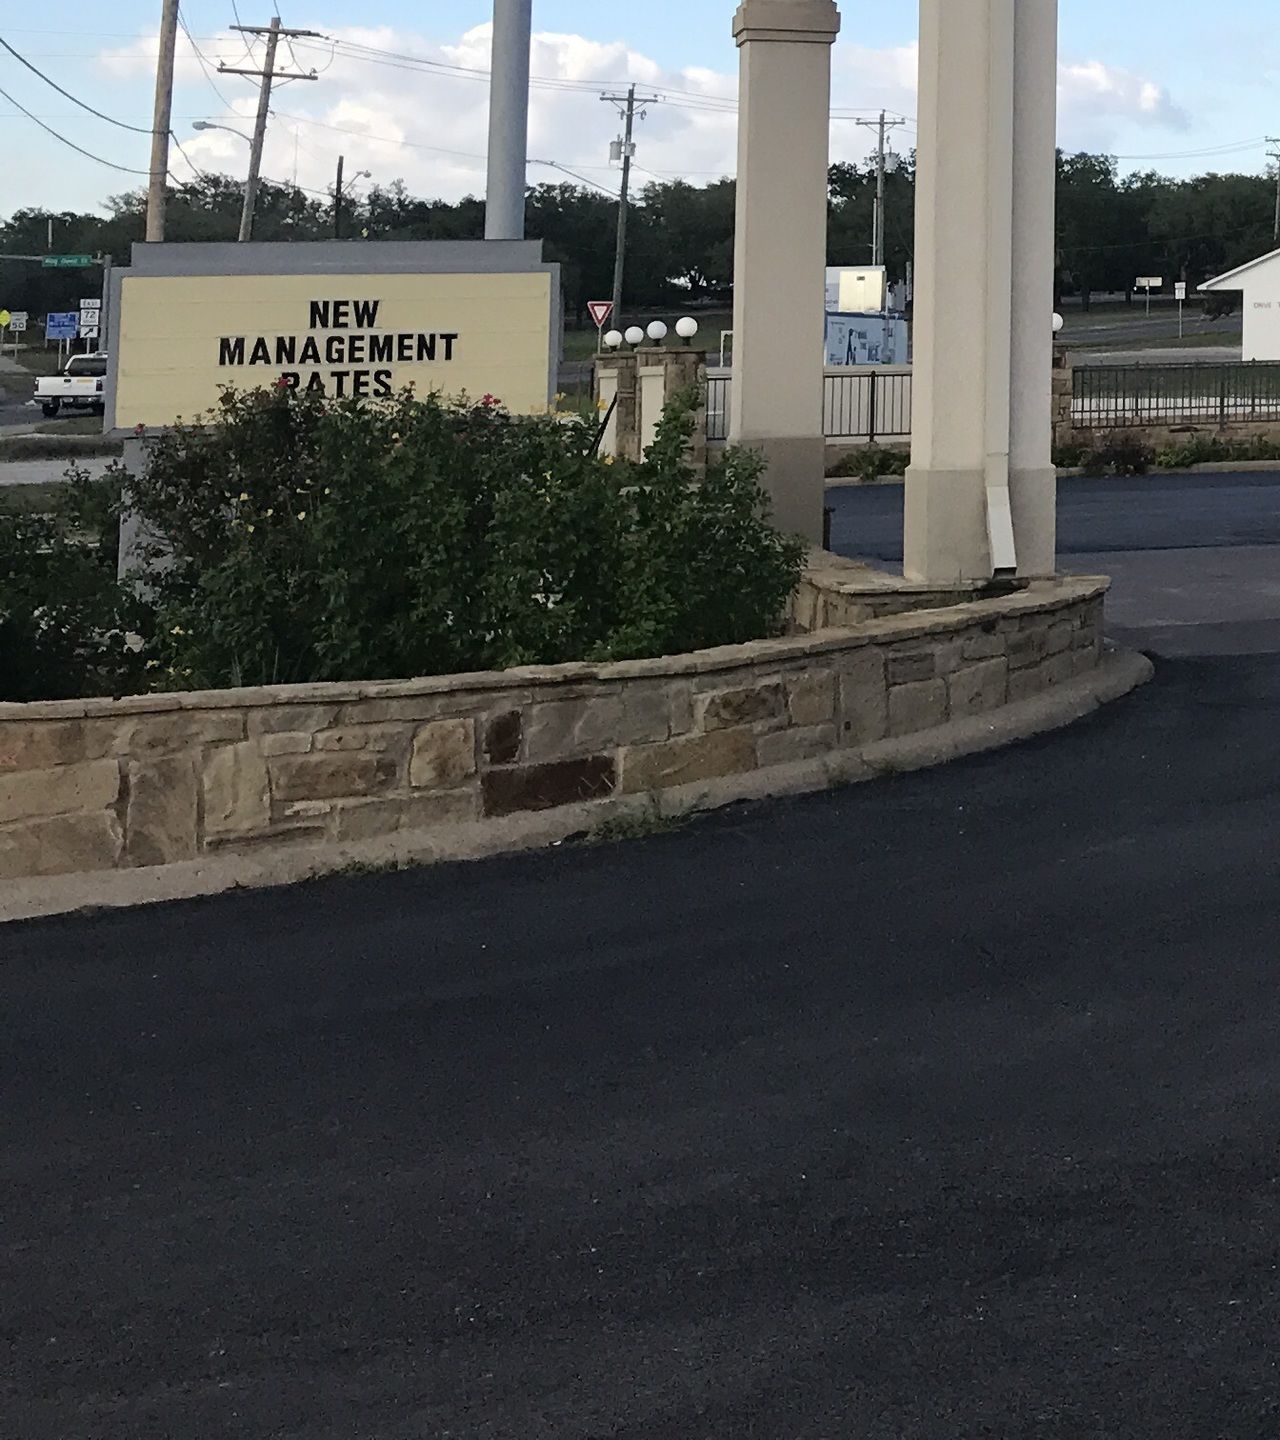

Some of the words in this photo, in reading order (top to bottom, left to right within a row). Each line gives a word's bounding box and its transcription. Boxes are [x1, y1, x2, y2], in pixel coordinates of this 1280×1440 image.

[84, 310, 96, 319] 72
[310, 300, 380, 328] NEW
[219, 333, 458, 365] MANAGEMENT
